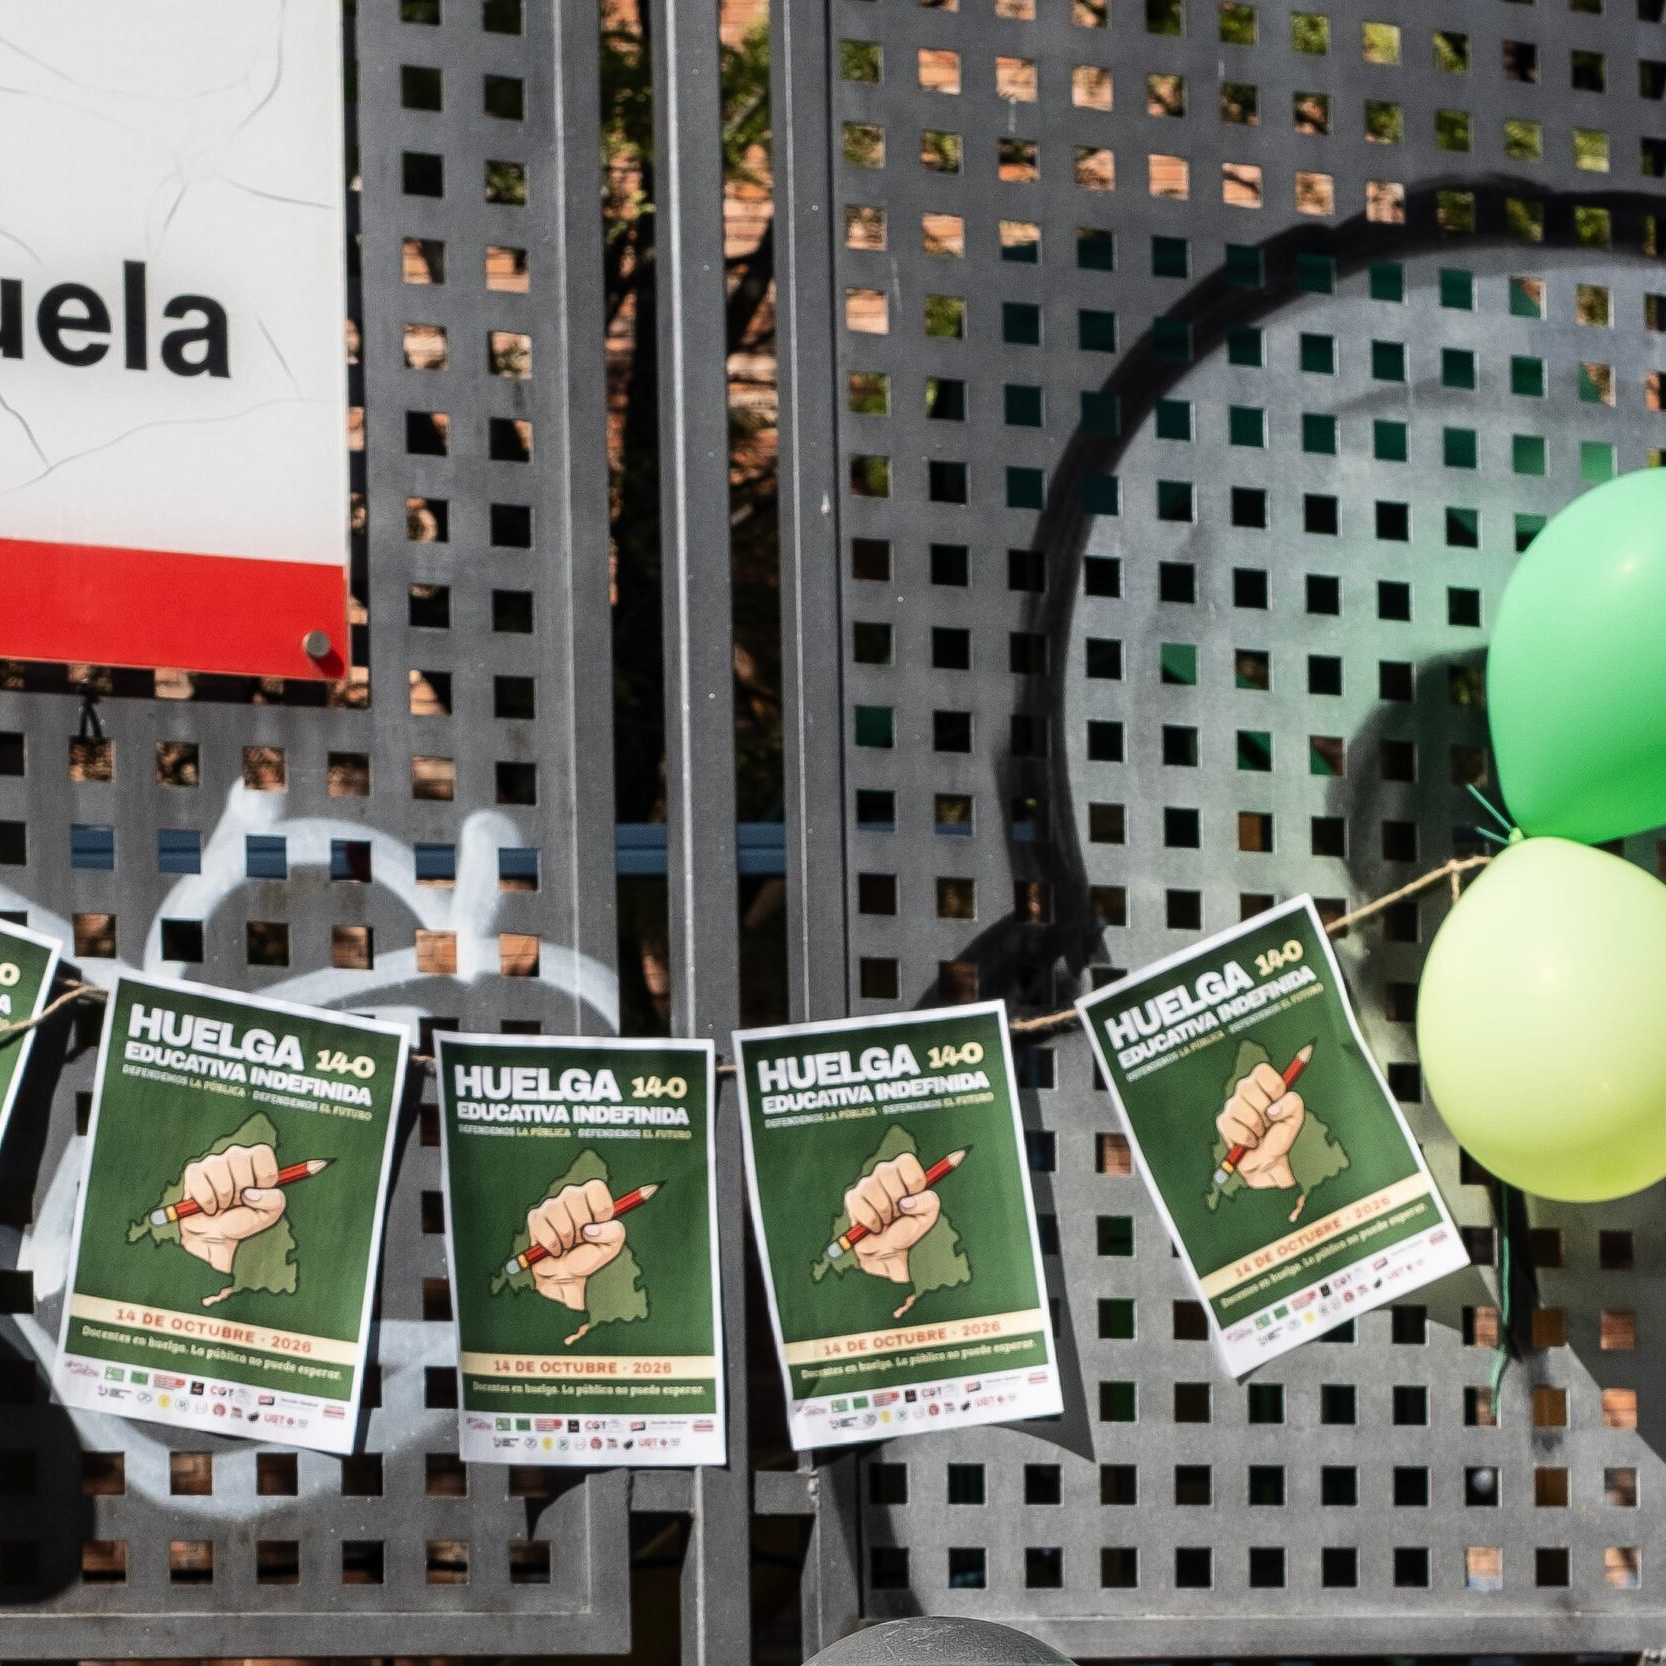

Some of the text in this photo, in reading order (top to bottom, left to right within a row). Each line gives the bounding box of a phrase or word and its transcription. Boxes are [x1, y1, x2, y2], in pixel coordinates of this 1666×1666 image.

[1104, 960, 1255, 1051] HUELGA
[1115, 962, 1317, 1071] EDUCATIVA INDEFINIDA
[126, 1001, 308, 1074] HUELGA
[123, 1039, 374, 1109] EDUCATIVA INDEFINIDA
[454, 1064, 622, 1103] HUELGA
[754, 1041, 921, 1095] HUELGA
[760, 1068, 991, 1116] EDUCATIVA INDEFINIDA
[456, 1100, 690, 1126] EDUCATIVA INDEFINIDA
[115, 1306, 312, 1353] 14 DE OCTUBRE 2026
[493, 1359, 672, 1374] 14 DE OCTUBRE 2026
